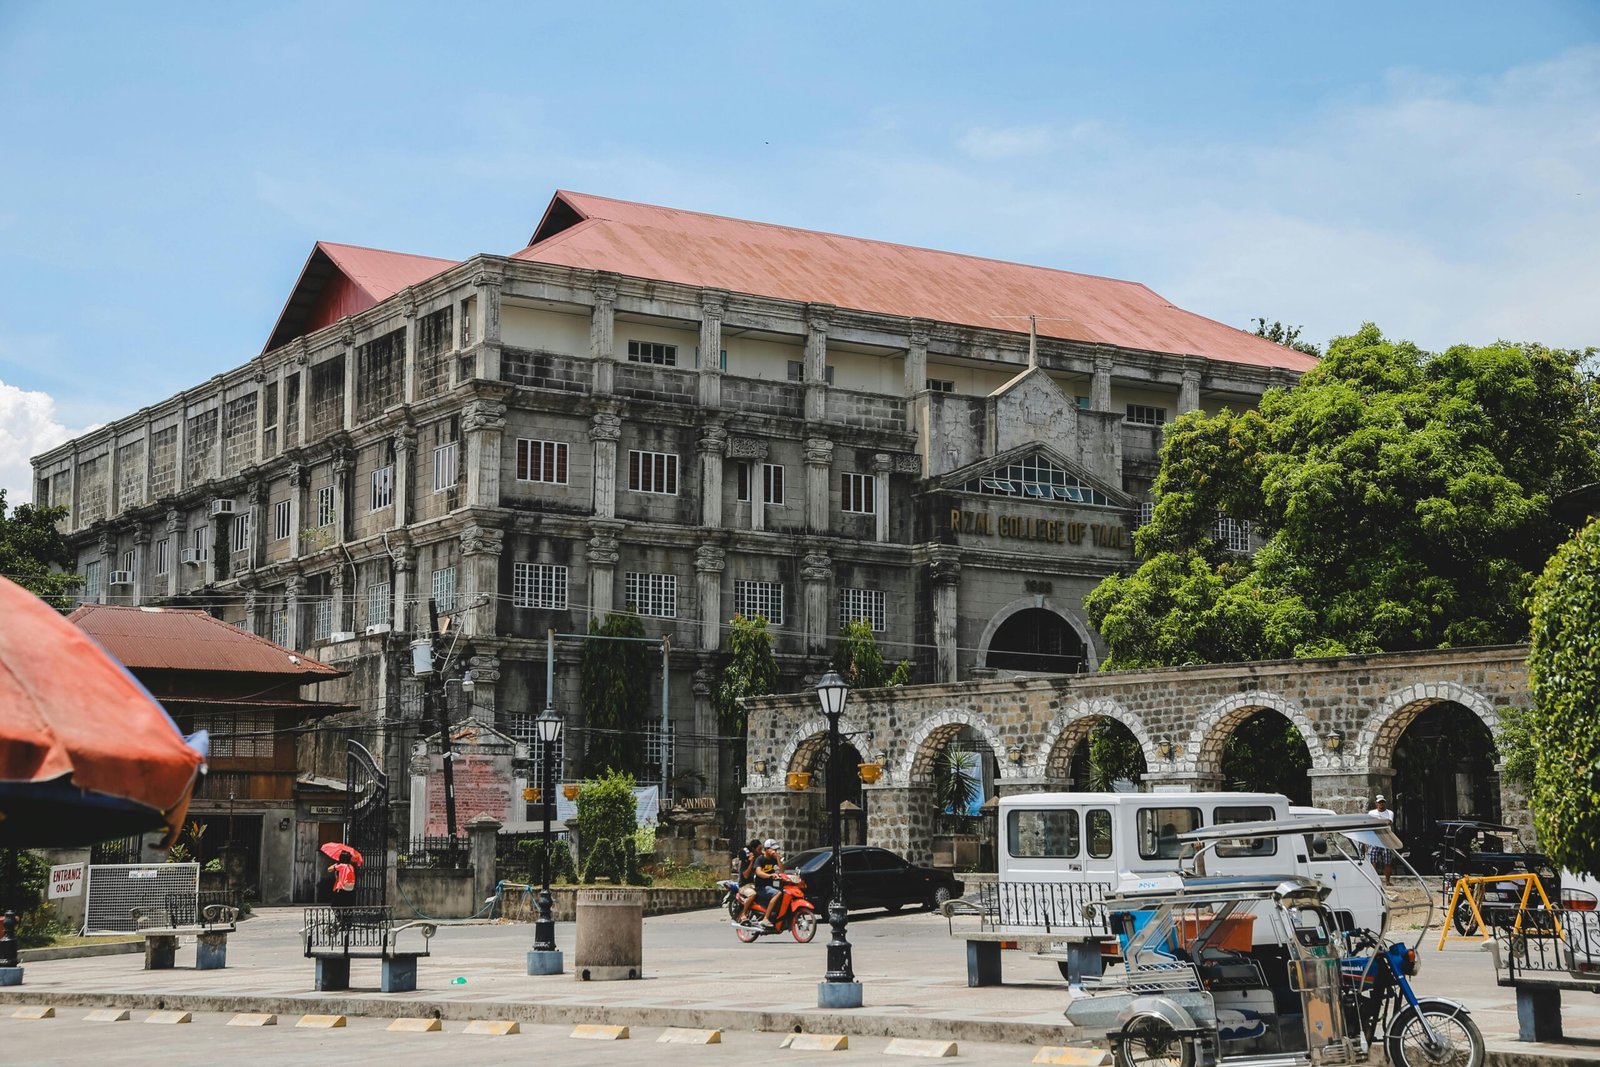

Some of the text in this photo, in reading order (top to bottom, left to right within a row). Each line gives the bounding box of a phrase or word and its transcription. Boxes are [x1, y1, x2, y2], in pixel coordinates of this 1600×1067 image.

[950, 510, 1129, 549] RIZAL COLLEGE OF TAAL
[53, 867, 82, 882] ENTRANCE
[55, 882, 74, 893] ONLY
